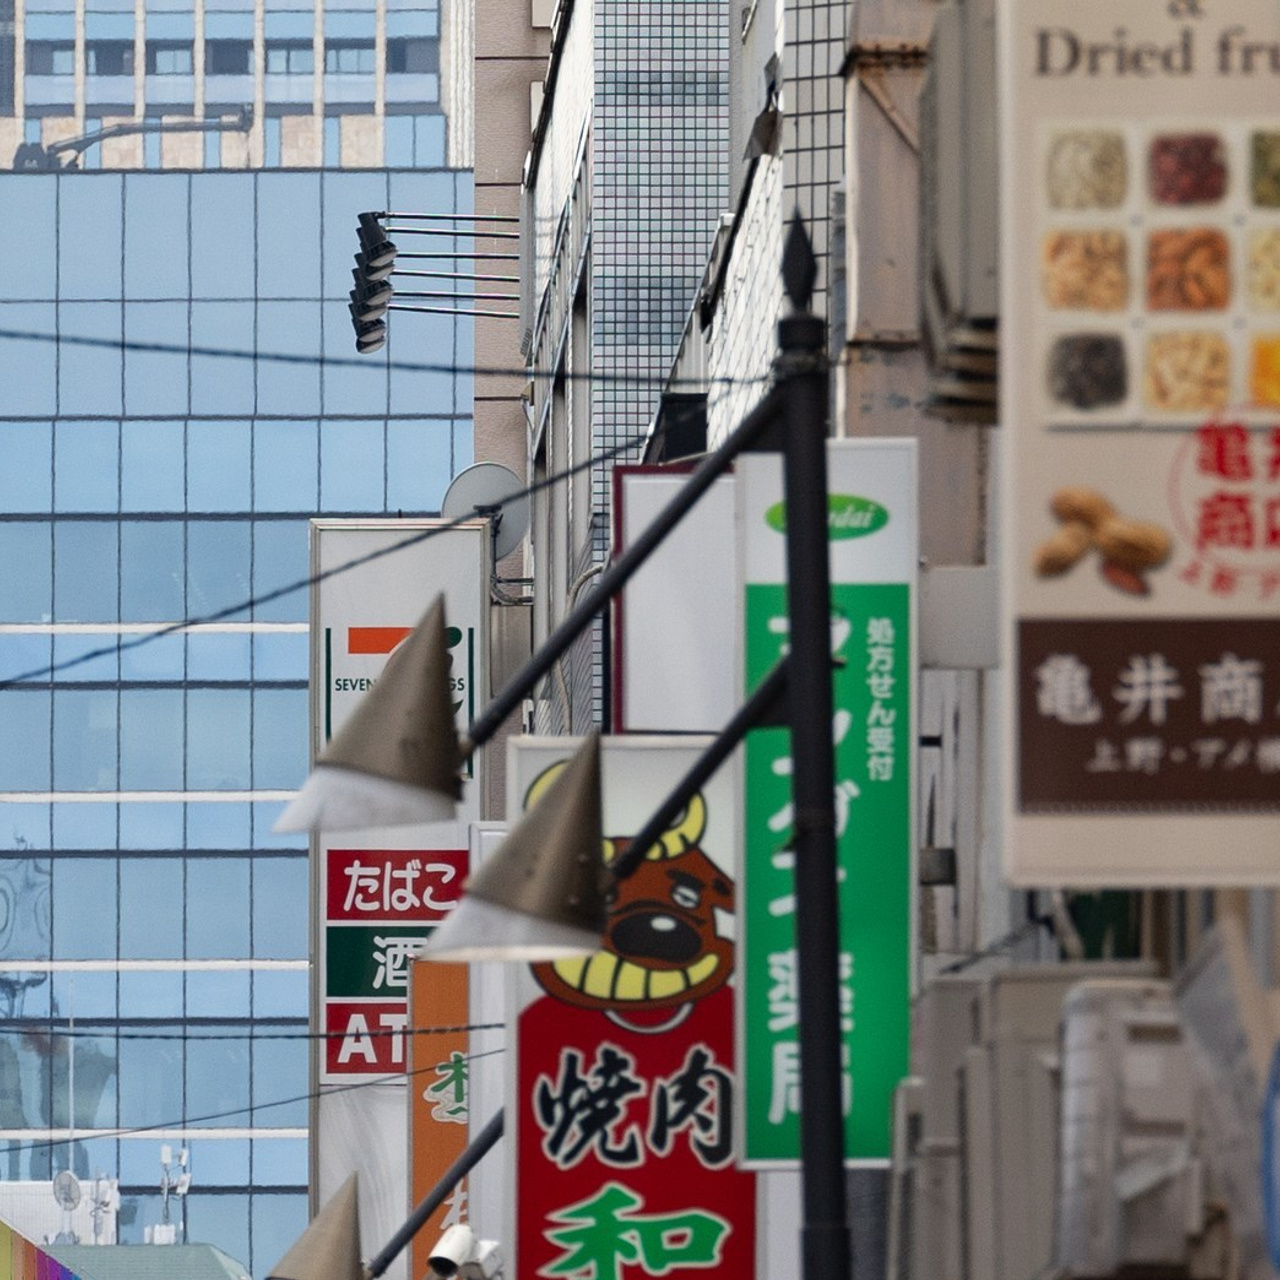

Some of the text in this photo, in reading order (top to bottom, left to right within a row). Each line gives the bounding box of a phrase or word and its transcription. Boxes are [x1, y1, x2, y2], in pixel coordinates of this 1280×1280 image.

[1035, 26, 1194, 78] Dried
[866, 616, 895, 781] 処方せん受付
[1034, 650, 1280, 725] 亀井商
[343, 859, 457, 912] たばこ
[337, 1013, 407, 1063] AT
[533, 1042, 734, 1168] 焼肉
